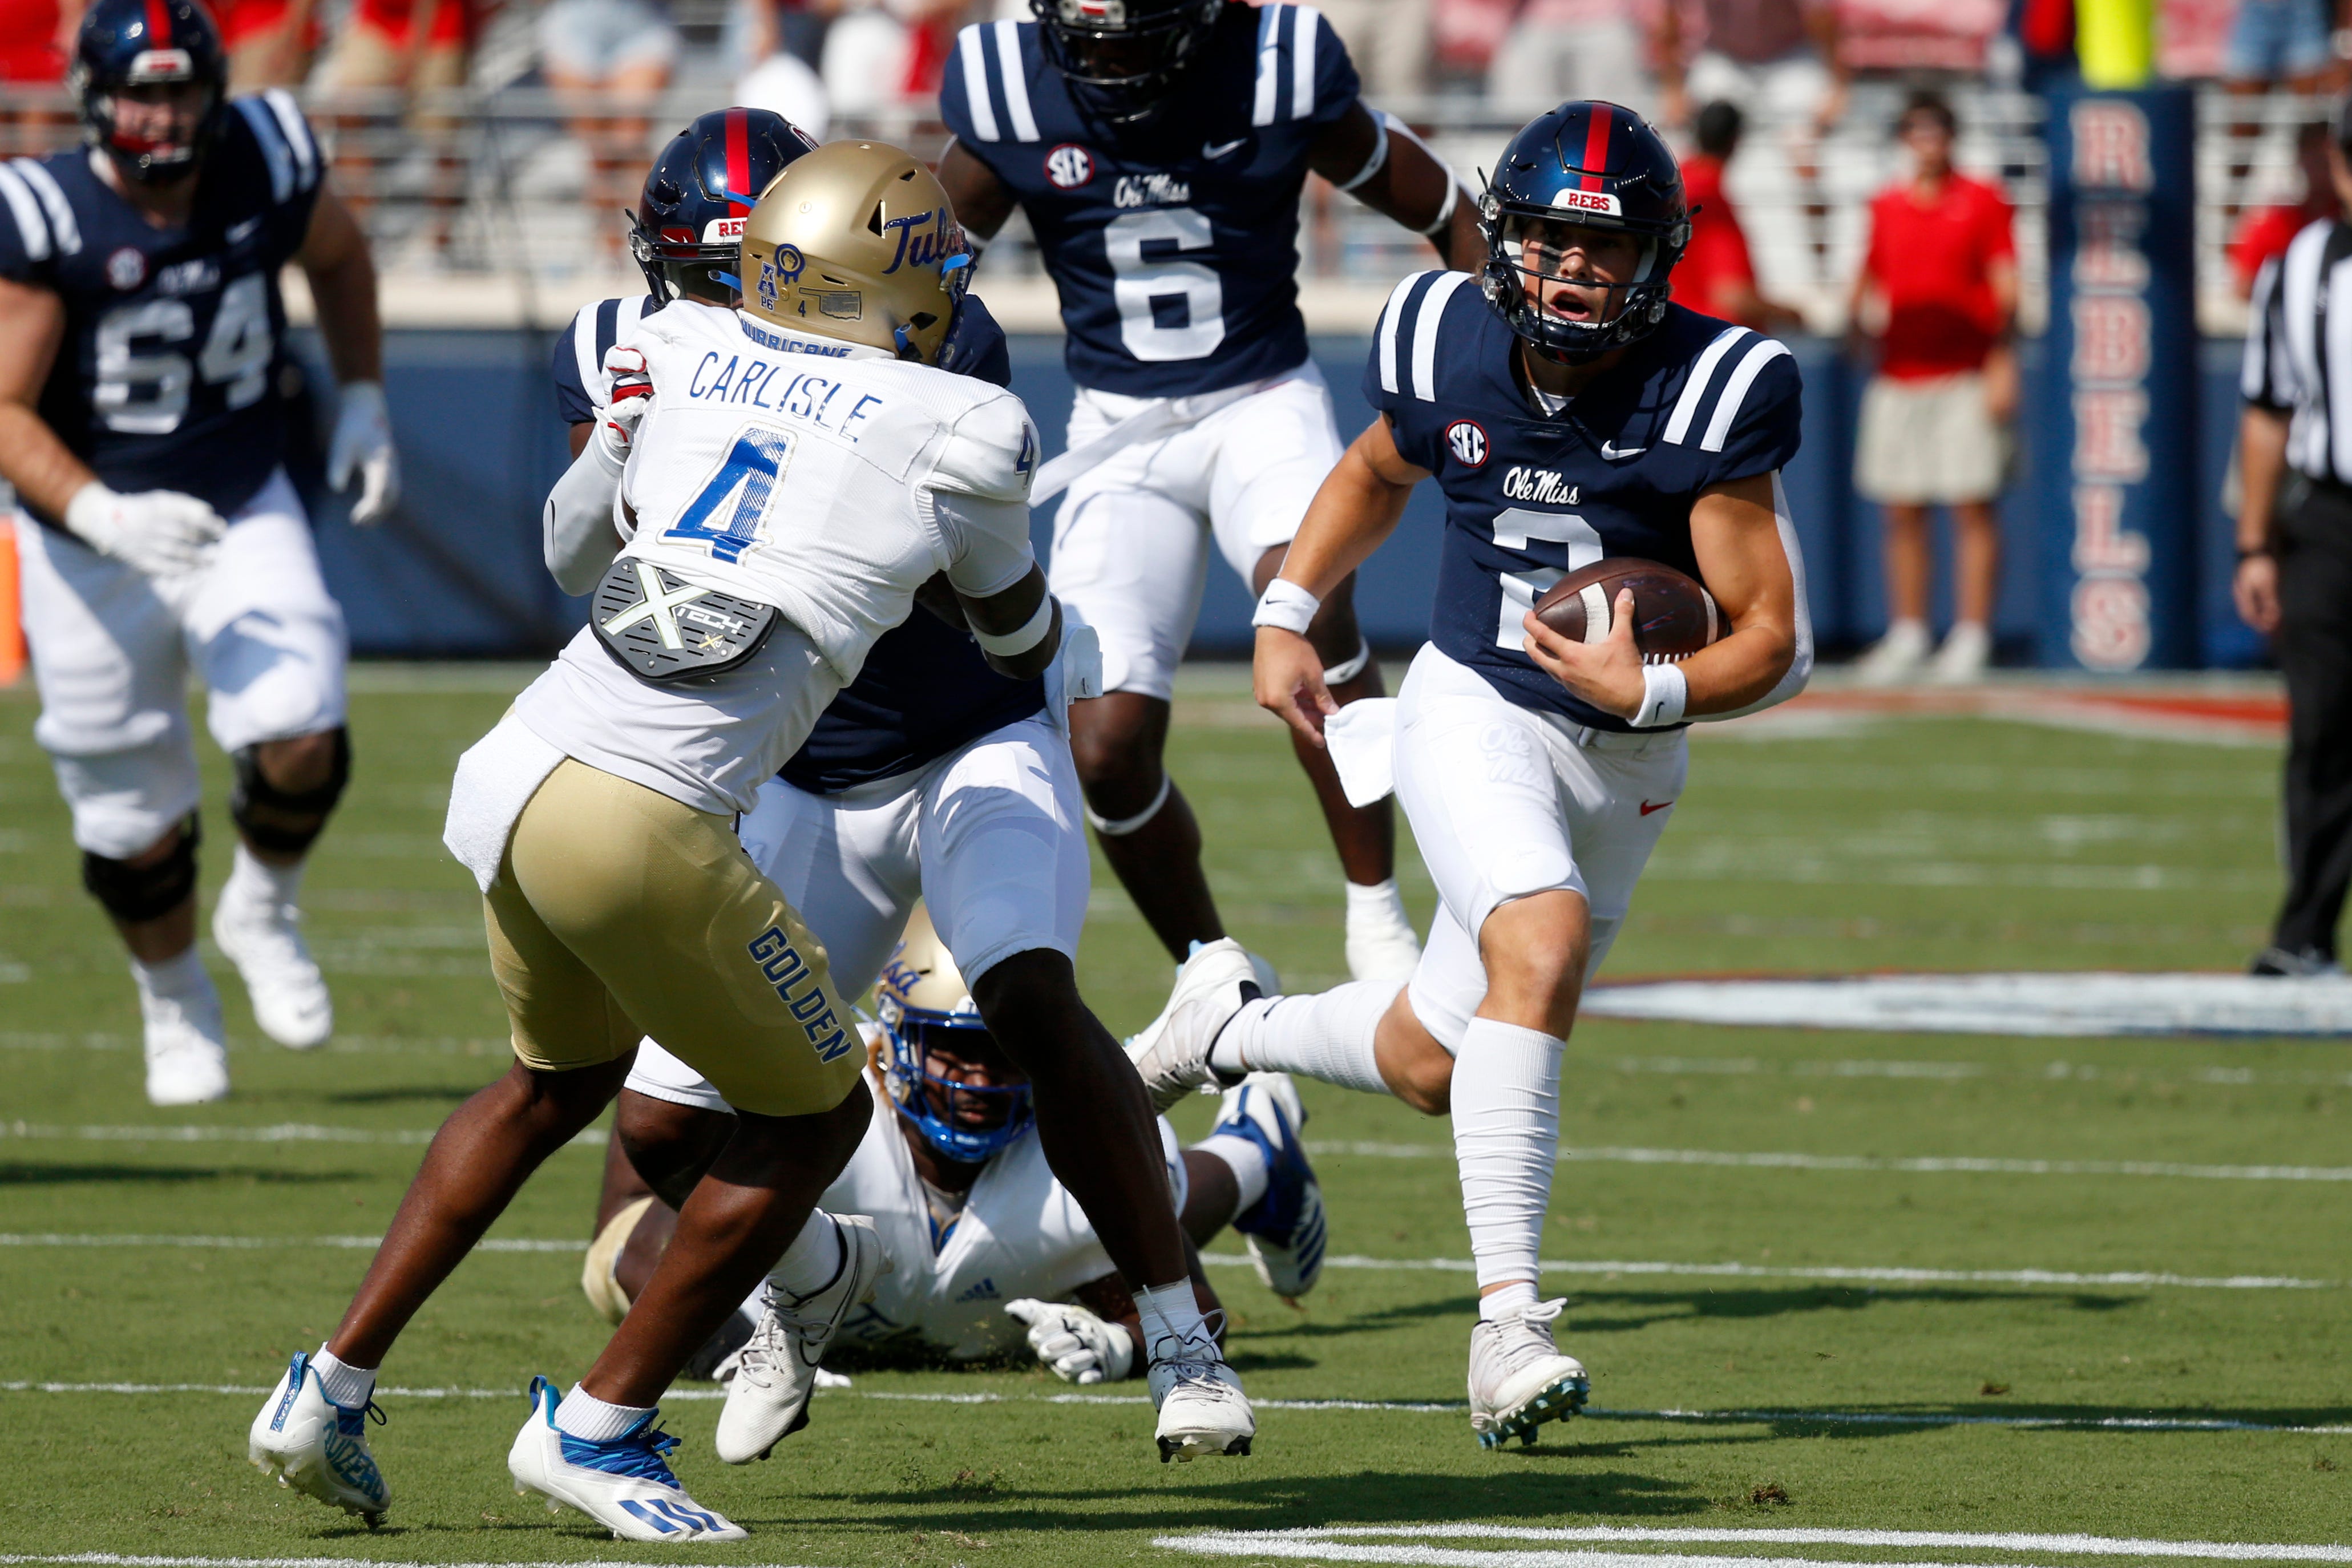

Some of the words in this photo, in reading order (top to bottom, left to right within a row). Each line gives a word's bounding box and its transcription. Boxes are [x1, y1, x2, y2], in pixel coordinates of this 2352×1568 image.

[1567, 192, 1611, 211] REBS
[761, 296, 775, 311] P6
[798, 300, 806, 317] 4
[1104, 207, 1226, 361] 6
[93, 270, 274, 434] 64
[689, 351, 883, 443] CARLISLE
[2070, 99, 2152, 672] REBELS
[1015, 421, 1034, 490] 4
[1448, 423, 1486, 465] SEC
[1503, 466, 1533, 500] Ole
[1532, 470, 1581, 506] Miss
[662, 425, 792, 565] 4
[1492, 507, 1604, 652] 2
[747, 924, 853, 1065] GOLDEN
